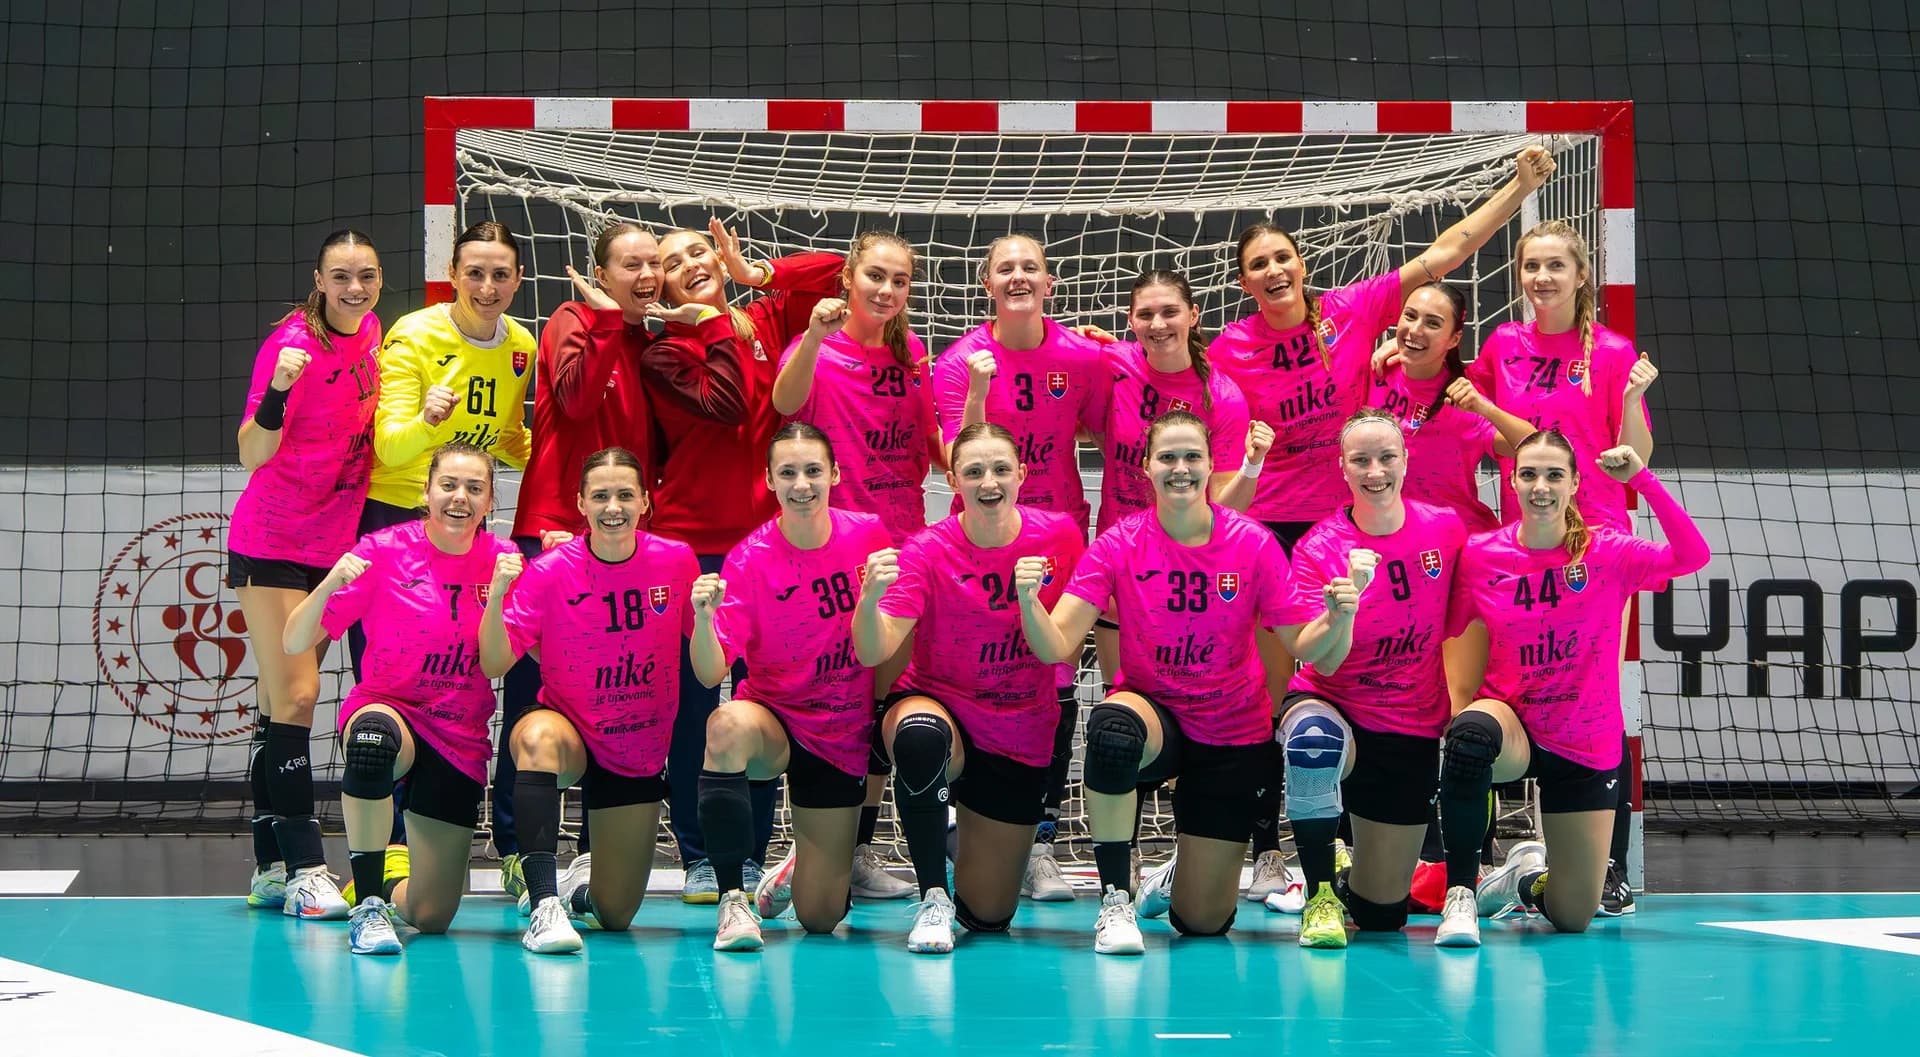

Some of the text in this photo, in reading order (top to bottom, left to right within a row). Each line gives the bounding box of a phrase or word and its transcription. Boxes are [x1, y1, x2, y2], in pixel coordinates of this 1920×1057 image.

[1272, 334, 1315, 371] 42
[349, 358, 376, 401] 11
[871, 365, 907, 397] 29
[1015, 373, 1034, 412] 3
[1525, 356, 1561, 393] 74
[467, 376, 497, 417] 61
[1141, 384, 1159, 420] 8
[1280, 377, 1336, 421] niké
[864, 420, 915, 450] niké
[1018, 432, 1054, 463] iké
[1115, 440, 1146, 467] ni
[812, 572, 856, 619] 38
[1168, 570, 1208, 612] 33
[1388, 560, 1410, 601] 9
[1514, 568, 1561, 611] 44
[443, 584, 462, 621] 7
[602, 589, 644, 633] 18
[816, 637, 859, 676] nik
[1156, 633, 1215, 666] niké
[1375, 623, 1432, 657] niké
[1520, 629, 1578, 666] niké
[1653, 578, 1917, 698] YAP
[595, 652, 655, 689] niké
[356, 732, 382, 742] SELECT
